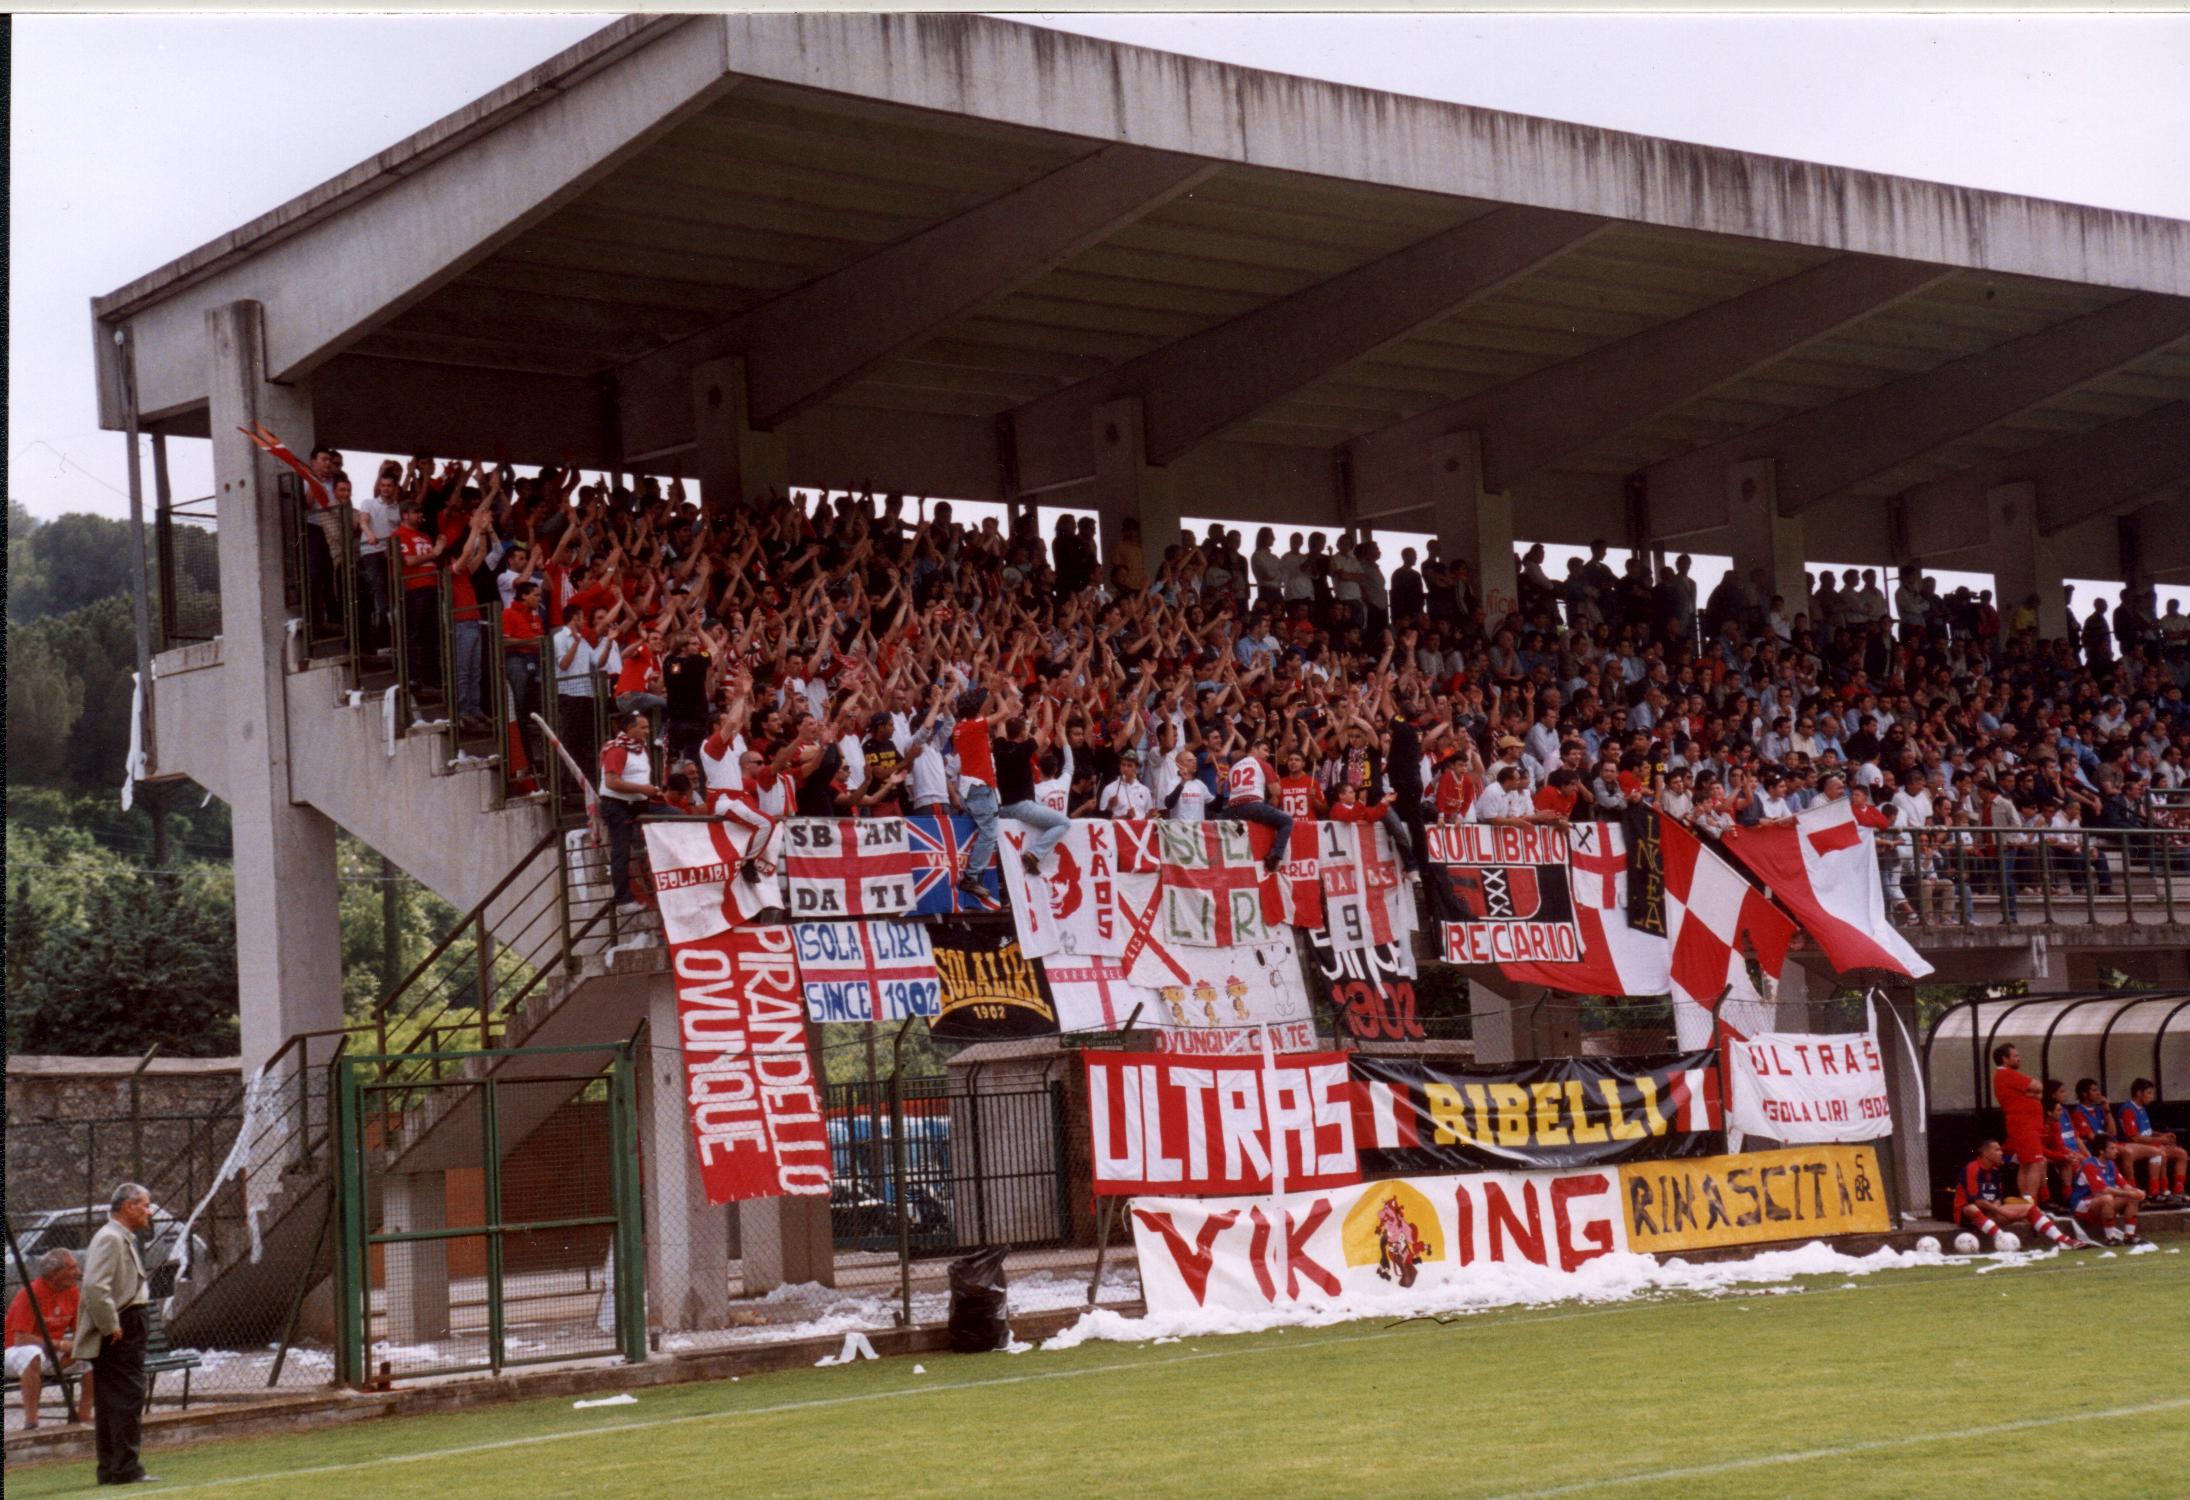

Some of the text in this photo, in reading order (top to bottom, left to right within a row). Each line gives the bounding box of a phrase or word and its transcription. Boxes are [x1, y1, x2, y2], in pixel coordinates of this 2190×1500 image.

[1231, 767, 1255, 788] 02
[1283, 795, 1308, 817] 03
[792, 922, 925, 962] ISOLA LIRI
[805, 981, 940, 1021] SINCE 1902
[972, 1004, 1007, 1020] 1902
[674, 948, 767, 1168] OVUNQUE
[1250, 1027, 1283, 1051] CN
[1288, 1025, 1311, 1048] TE
[1749, 1040, 1881, 1076] ULTRAS
[733, 926, 832, 1197] PIRANDELLO
[1089, 1061, 1358, 1182] ULTRAS
[1423, 1076, 1668, 1147] RIBELLI
[1815, 1099, 1849, 1122] LIRI
[1858, 1095, 1891, 1119] 1902
[1628, 1161, 1853, 1236] RINASCITA
